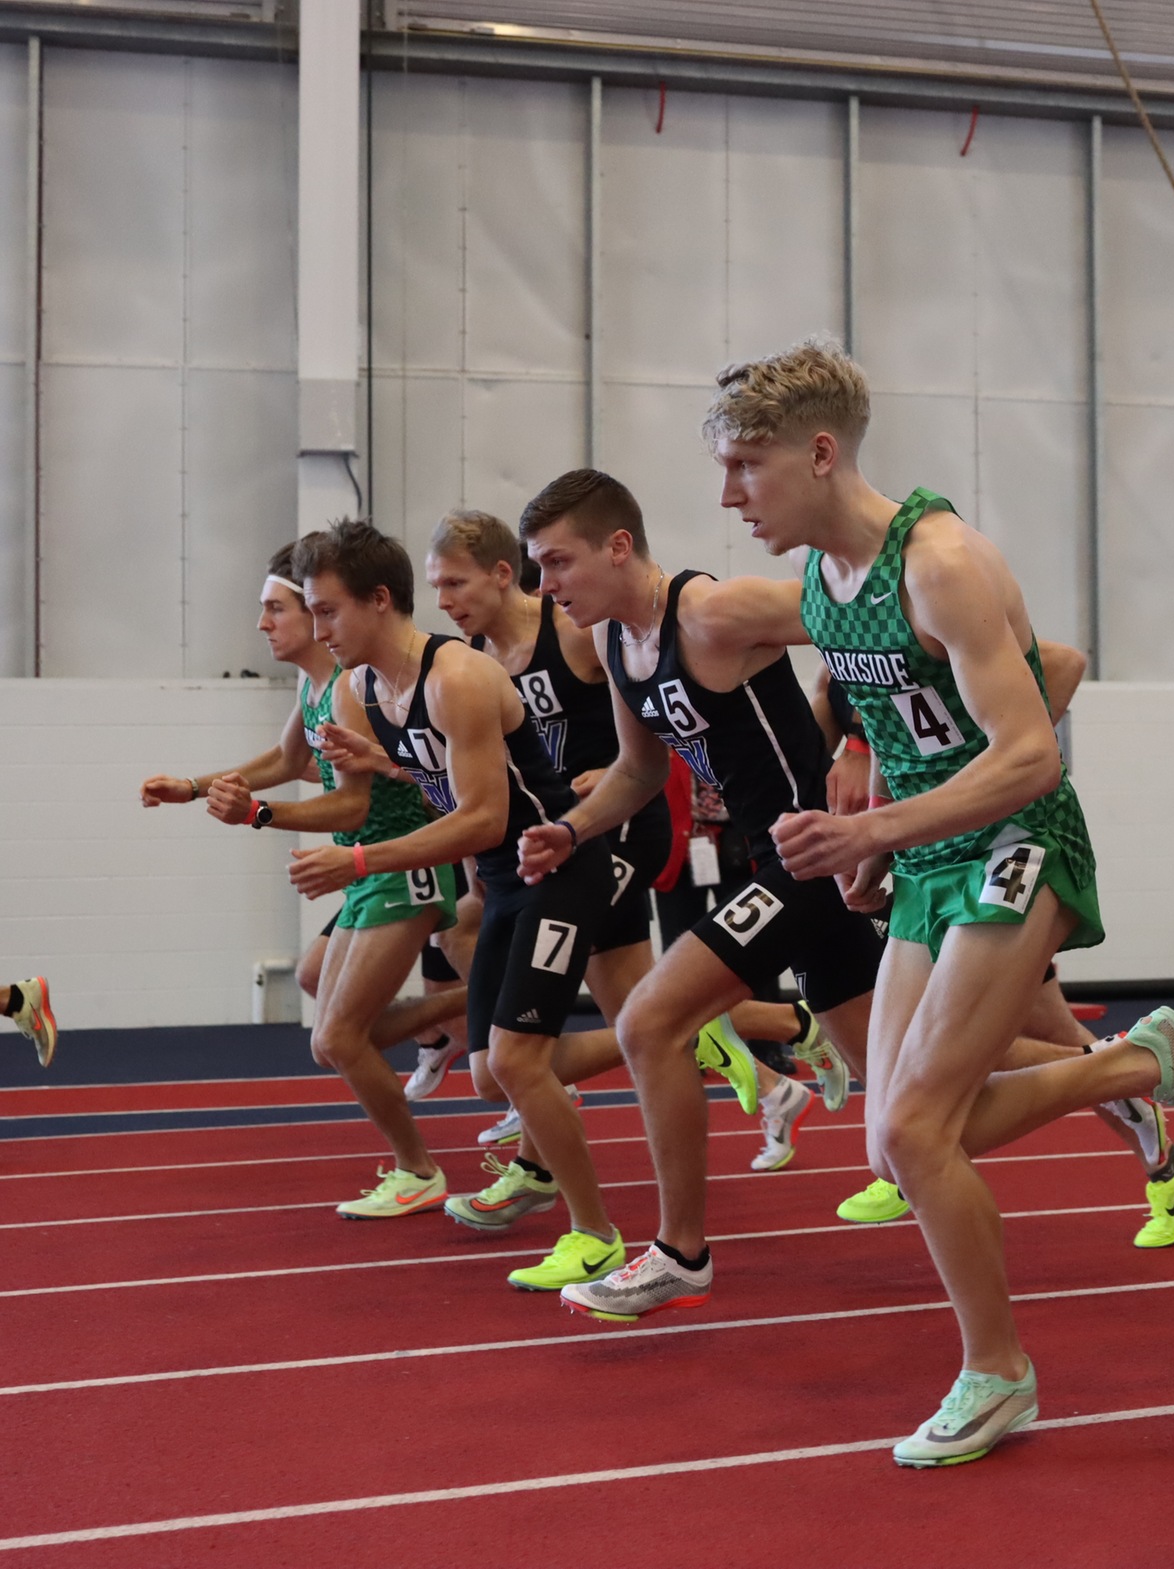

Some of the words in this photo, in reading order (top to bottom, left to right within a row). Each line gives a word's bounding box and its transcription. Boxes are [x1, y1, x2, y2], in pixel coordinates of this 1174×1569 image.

[817, 648, 920, 690] ARKSIDE
[529, 676, 554, 714] 8
[663, 685, 697, 732] 5
[910, 692, 951, 746] 4
[413, 733, 440, 769] 7
[411, 868, 436, 901] 9
[989, 847, 1031, 904] 4
[723, 887, 774, 933] 5
[543, 923, 570, 968] 7
